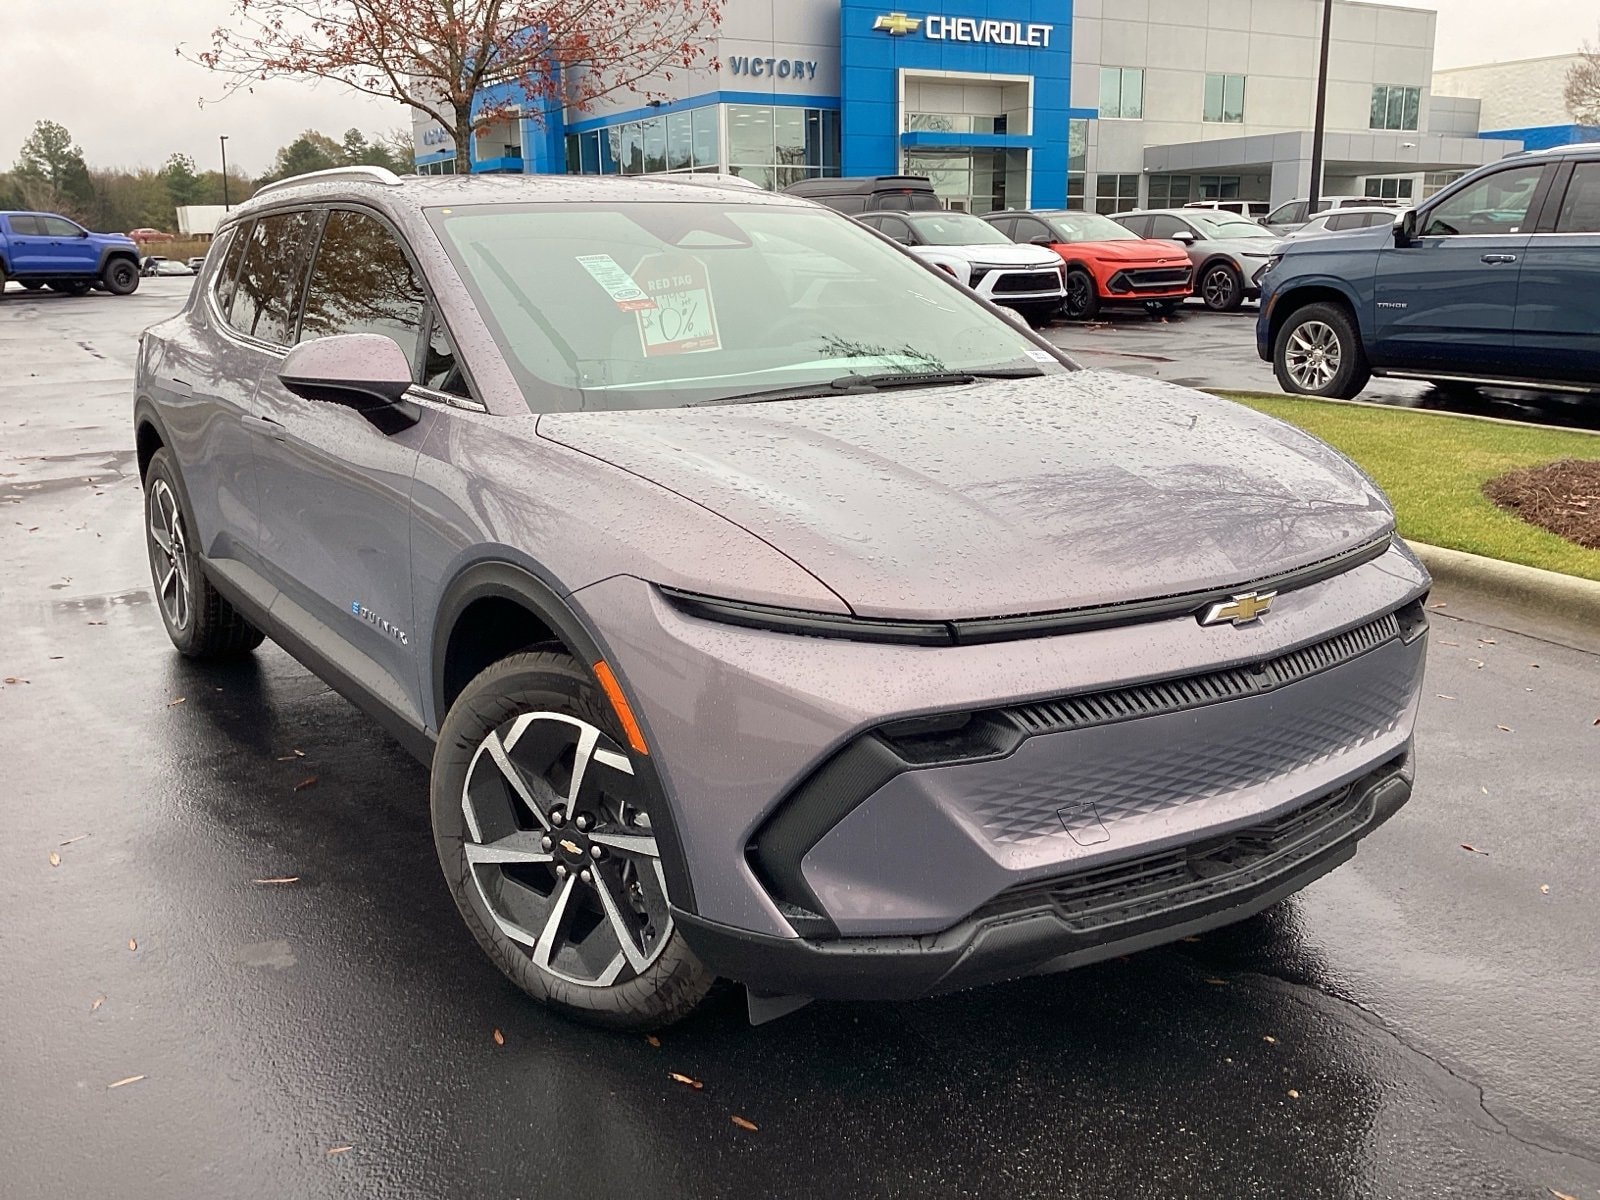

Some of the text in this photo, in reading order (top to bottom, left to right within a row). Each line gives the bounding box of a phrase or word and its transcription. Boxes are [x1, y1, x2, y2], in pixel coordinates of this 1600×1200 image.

[925, 15, 1054, 47] CHEVROLET
[729, 56, 818, 80] VICTORY
[647, 277, 670, 291] RED
[672, 274, 693, 286] TAG
